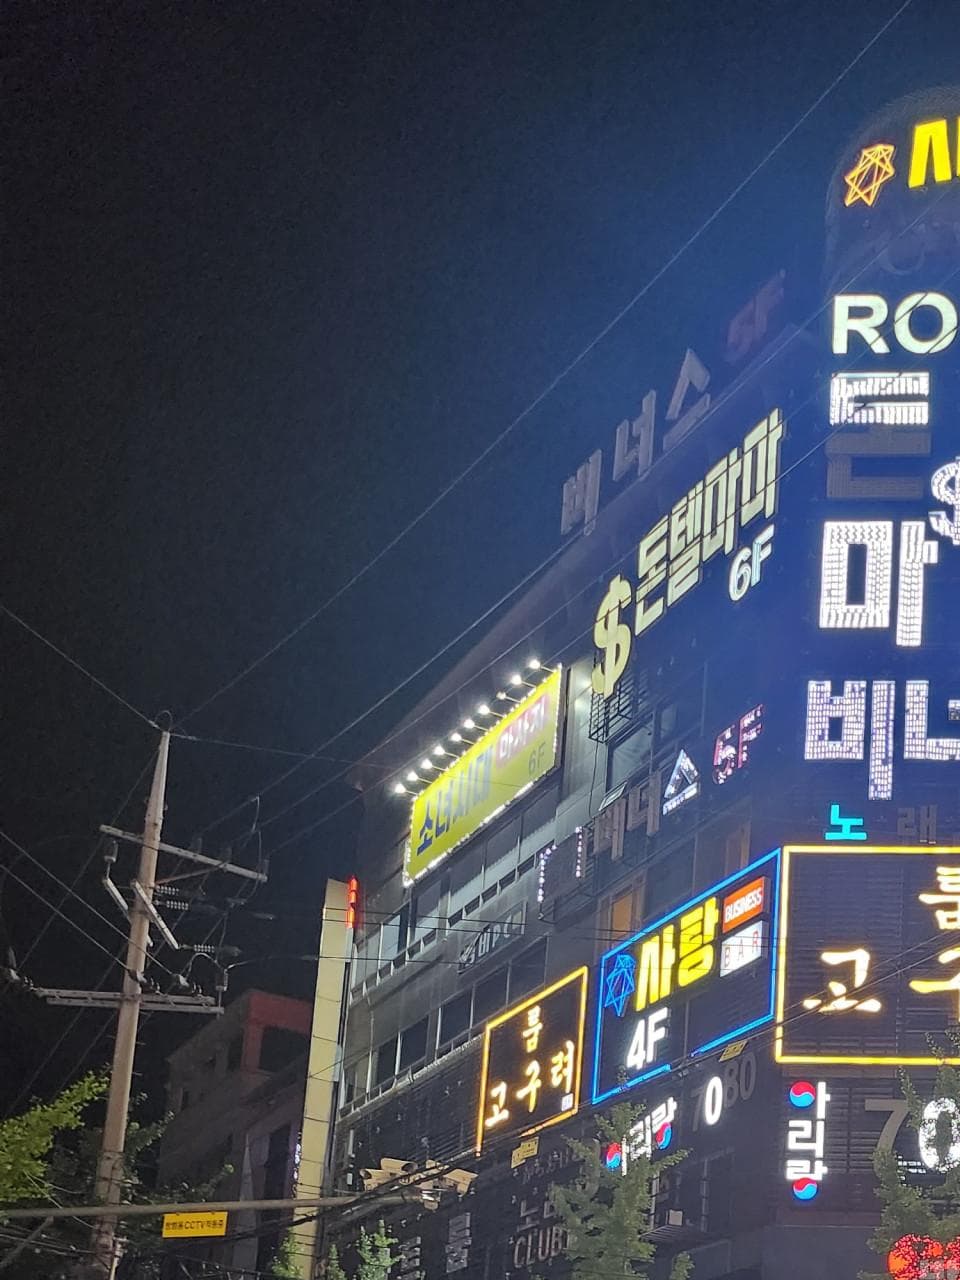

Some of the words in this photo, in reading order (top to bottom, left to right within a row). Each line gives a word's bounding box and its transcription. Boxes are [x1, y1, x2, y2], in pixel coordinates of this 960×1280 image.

[728, 523, 775, 603] 6F
[711, 703, 763, 785] 5F
[724, 885, 764, 924] BUSINESS
[635, 896, 720, 1012] 사탕
[723, 928, 760, 969] BAR
[521, 1005, 544, 1054] 룸
[626, 1006, 669, 1071] 4F
[484, 1039, 576, 1128] 고구려
